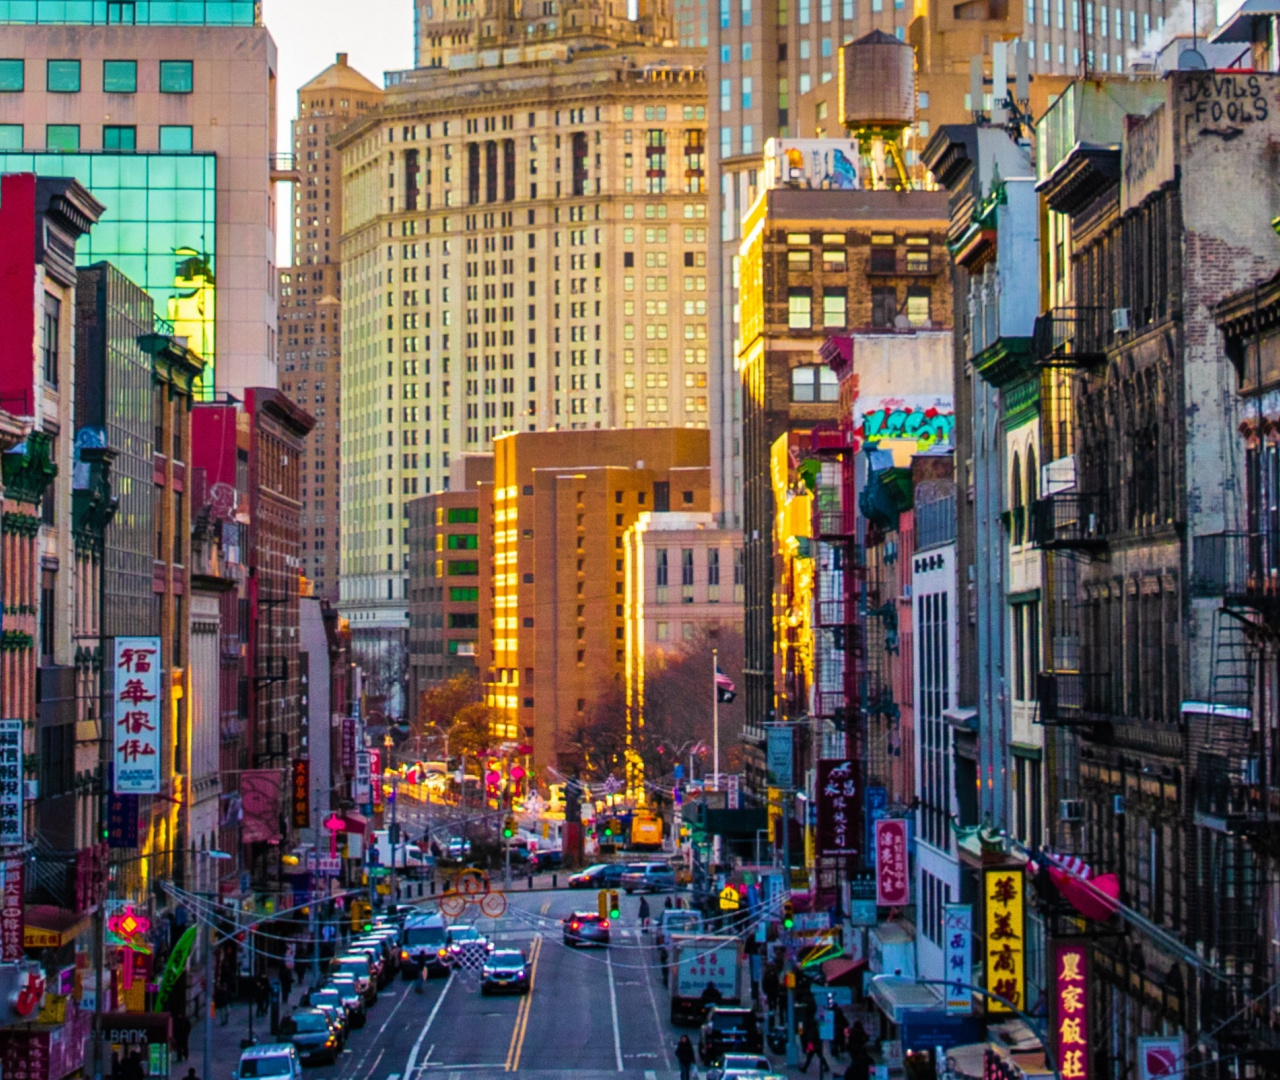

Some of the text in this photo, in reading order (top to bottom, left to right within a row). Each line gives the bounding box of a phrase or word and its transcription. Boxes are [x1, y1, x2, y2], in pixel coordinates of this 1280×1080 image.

[1195, 96, 1269, 124] FOOLS
[117, 647, 157, 764] 福華傢俬
[989, 875, 1021, 1007] 華美商場
[110, 1029, 148, 1043] BANK
